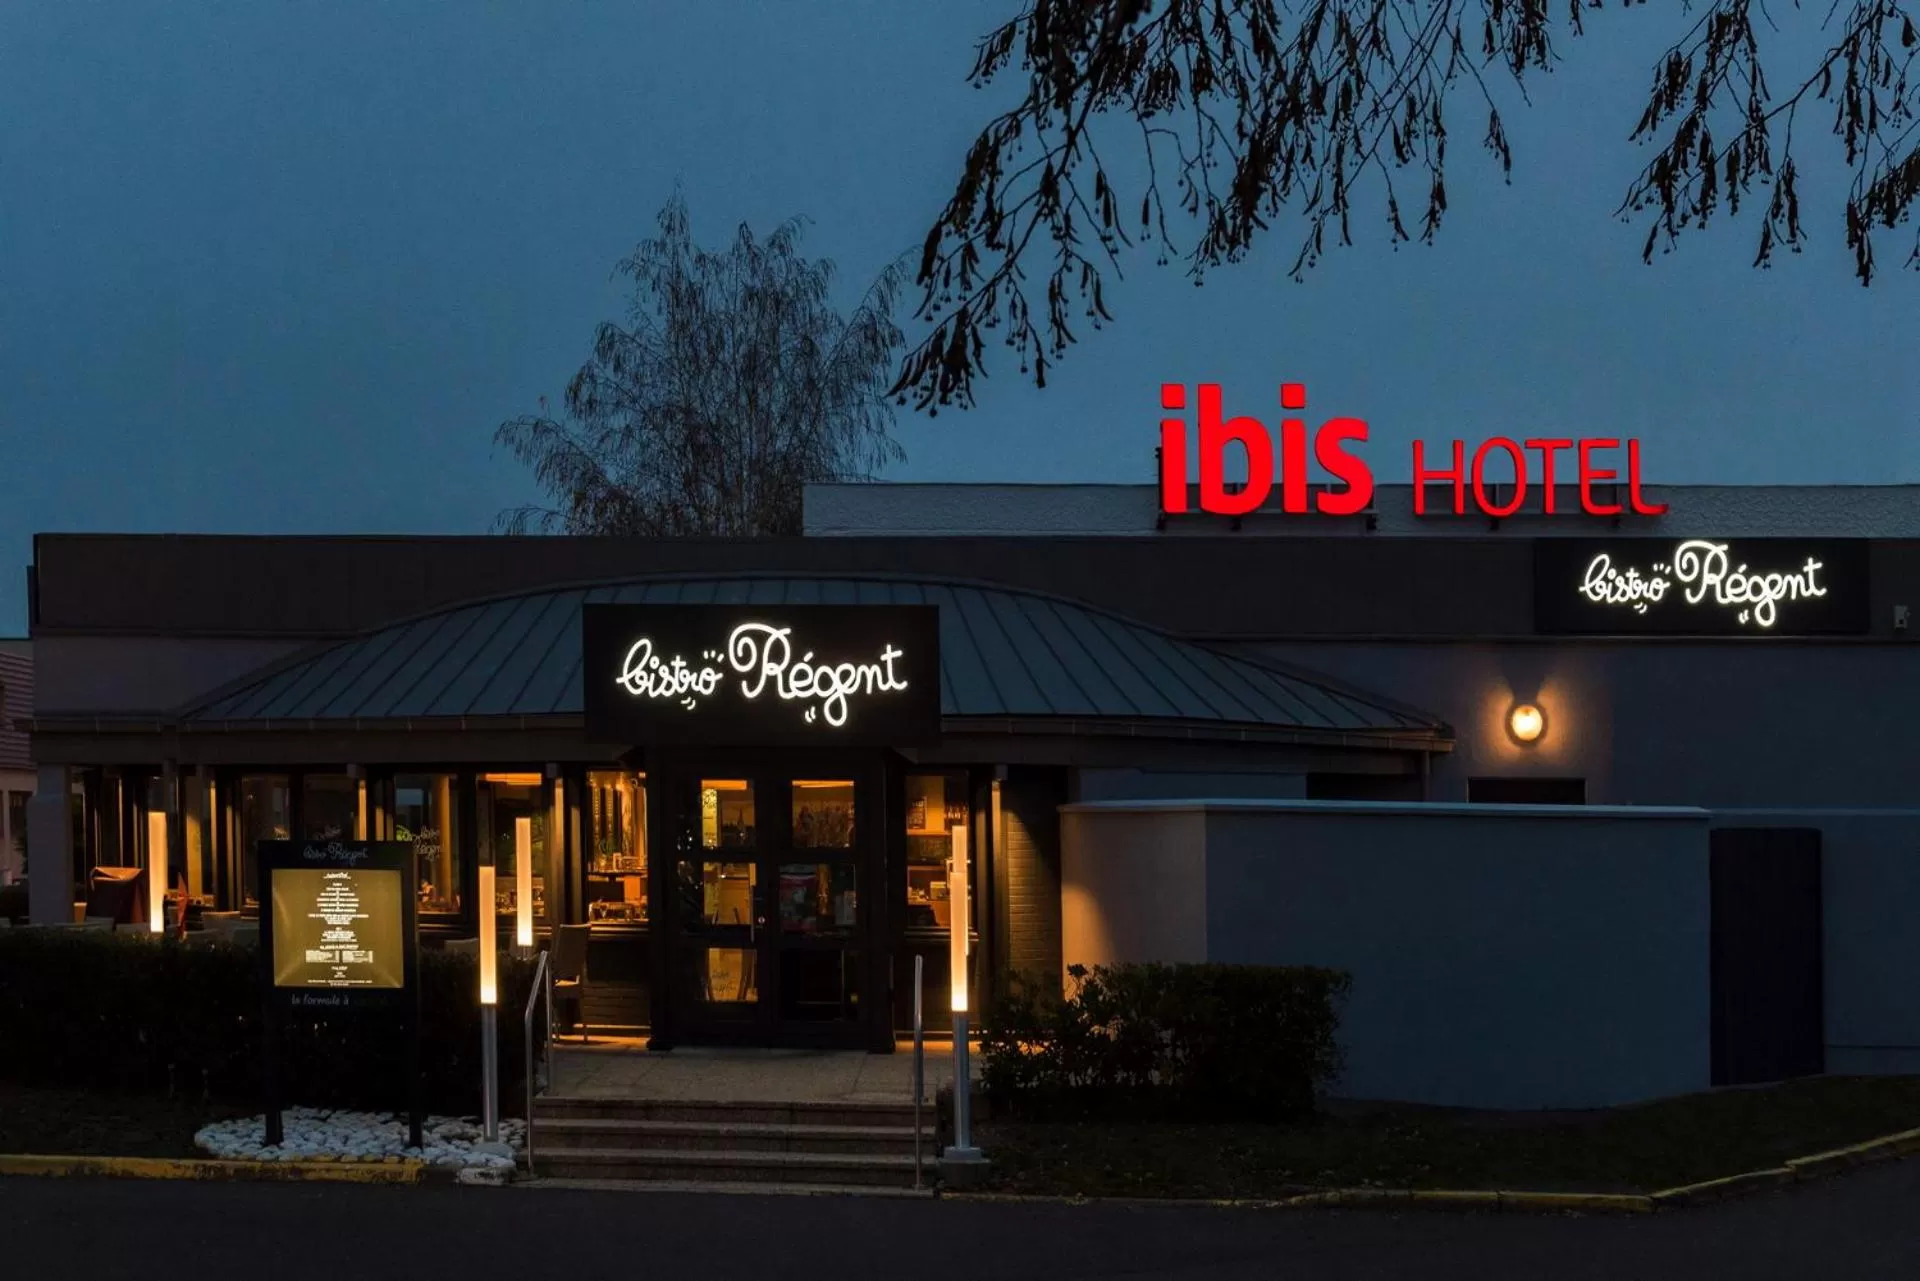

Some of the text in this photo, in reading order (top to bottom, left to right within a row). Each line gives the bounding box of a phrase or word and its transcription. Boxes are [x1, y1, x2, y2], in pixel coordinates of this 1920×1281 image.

[1160, 383, 1669, 516] ibis HOTEL
[1577, 540, 1828, 627] bistro Régent
[615, 621, 909, 728] bistro Régent
